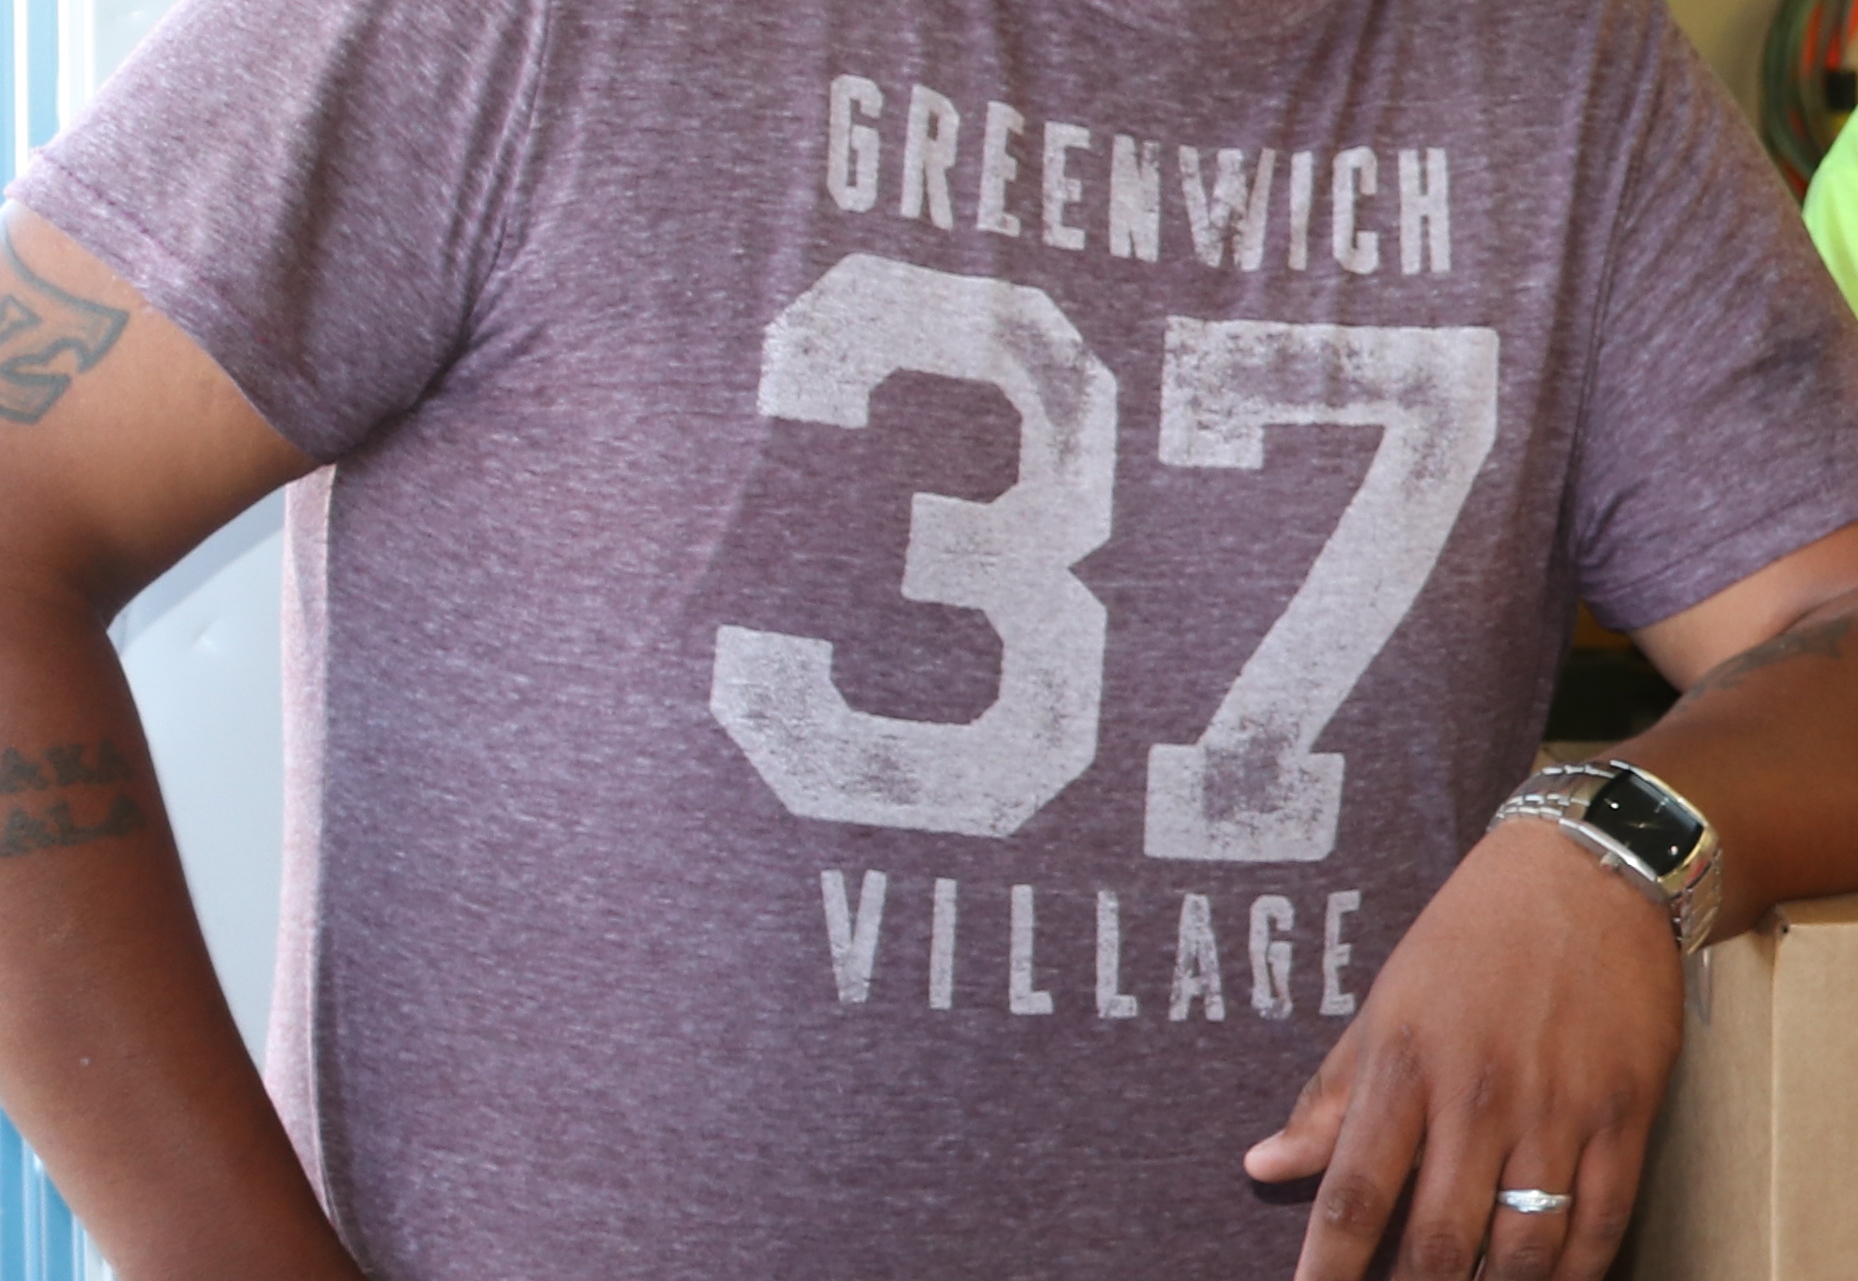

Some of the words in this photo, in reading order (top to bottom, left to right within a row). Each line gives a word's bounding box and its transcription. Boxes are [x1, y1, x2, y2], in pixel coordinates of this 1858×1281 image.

[825, 72, 1452, 276] GREENWICH
[709, 252, 1500, 862] 37
[820, 867, 1363, 1022] VILLAGE
